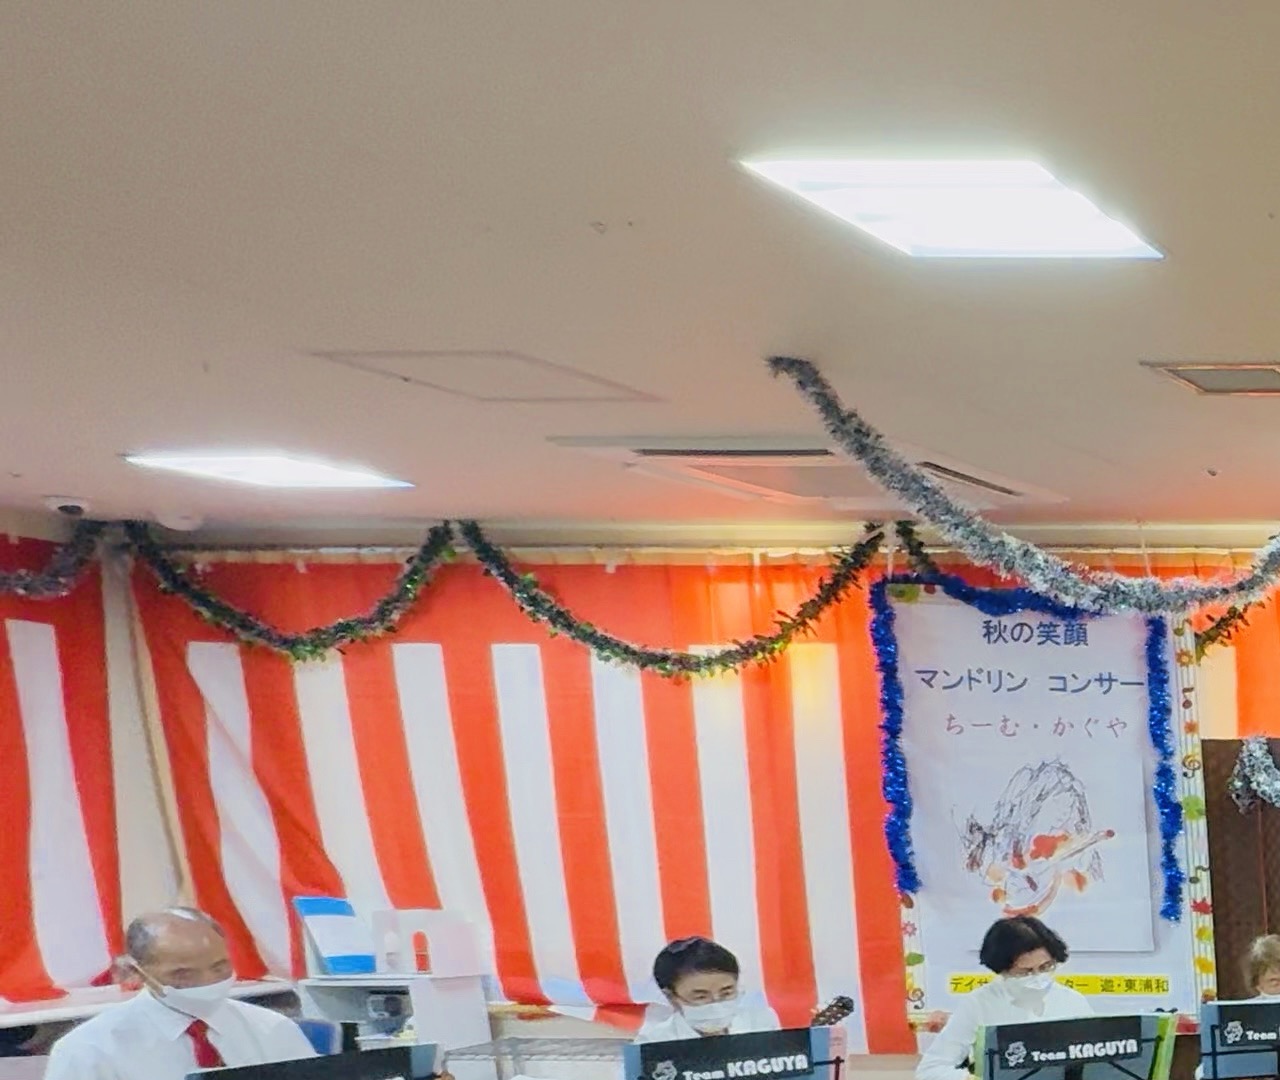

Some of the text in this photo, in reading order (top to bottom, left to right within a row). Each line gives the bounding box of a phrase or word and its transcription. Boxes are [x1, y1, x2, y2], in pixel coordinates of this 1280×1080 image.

[982, 620, 1089, 647] 秋の笑顔
[914, 667, 1145, 695] マンドリン コンサー
[945, 713, 1128, 738] ちーむ・かぐや
[1246, 1031, 1277, 1041] Team
[1031, 1038, 1138, 1062] Team KAGUYA
[727, 1054, 809, 1078] KAGUYA
